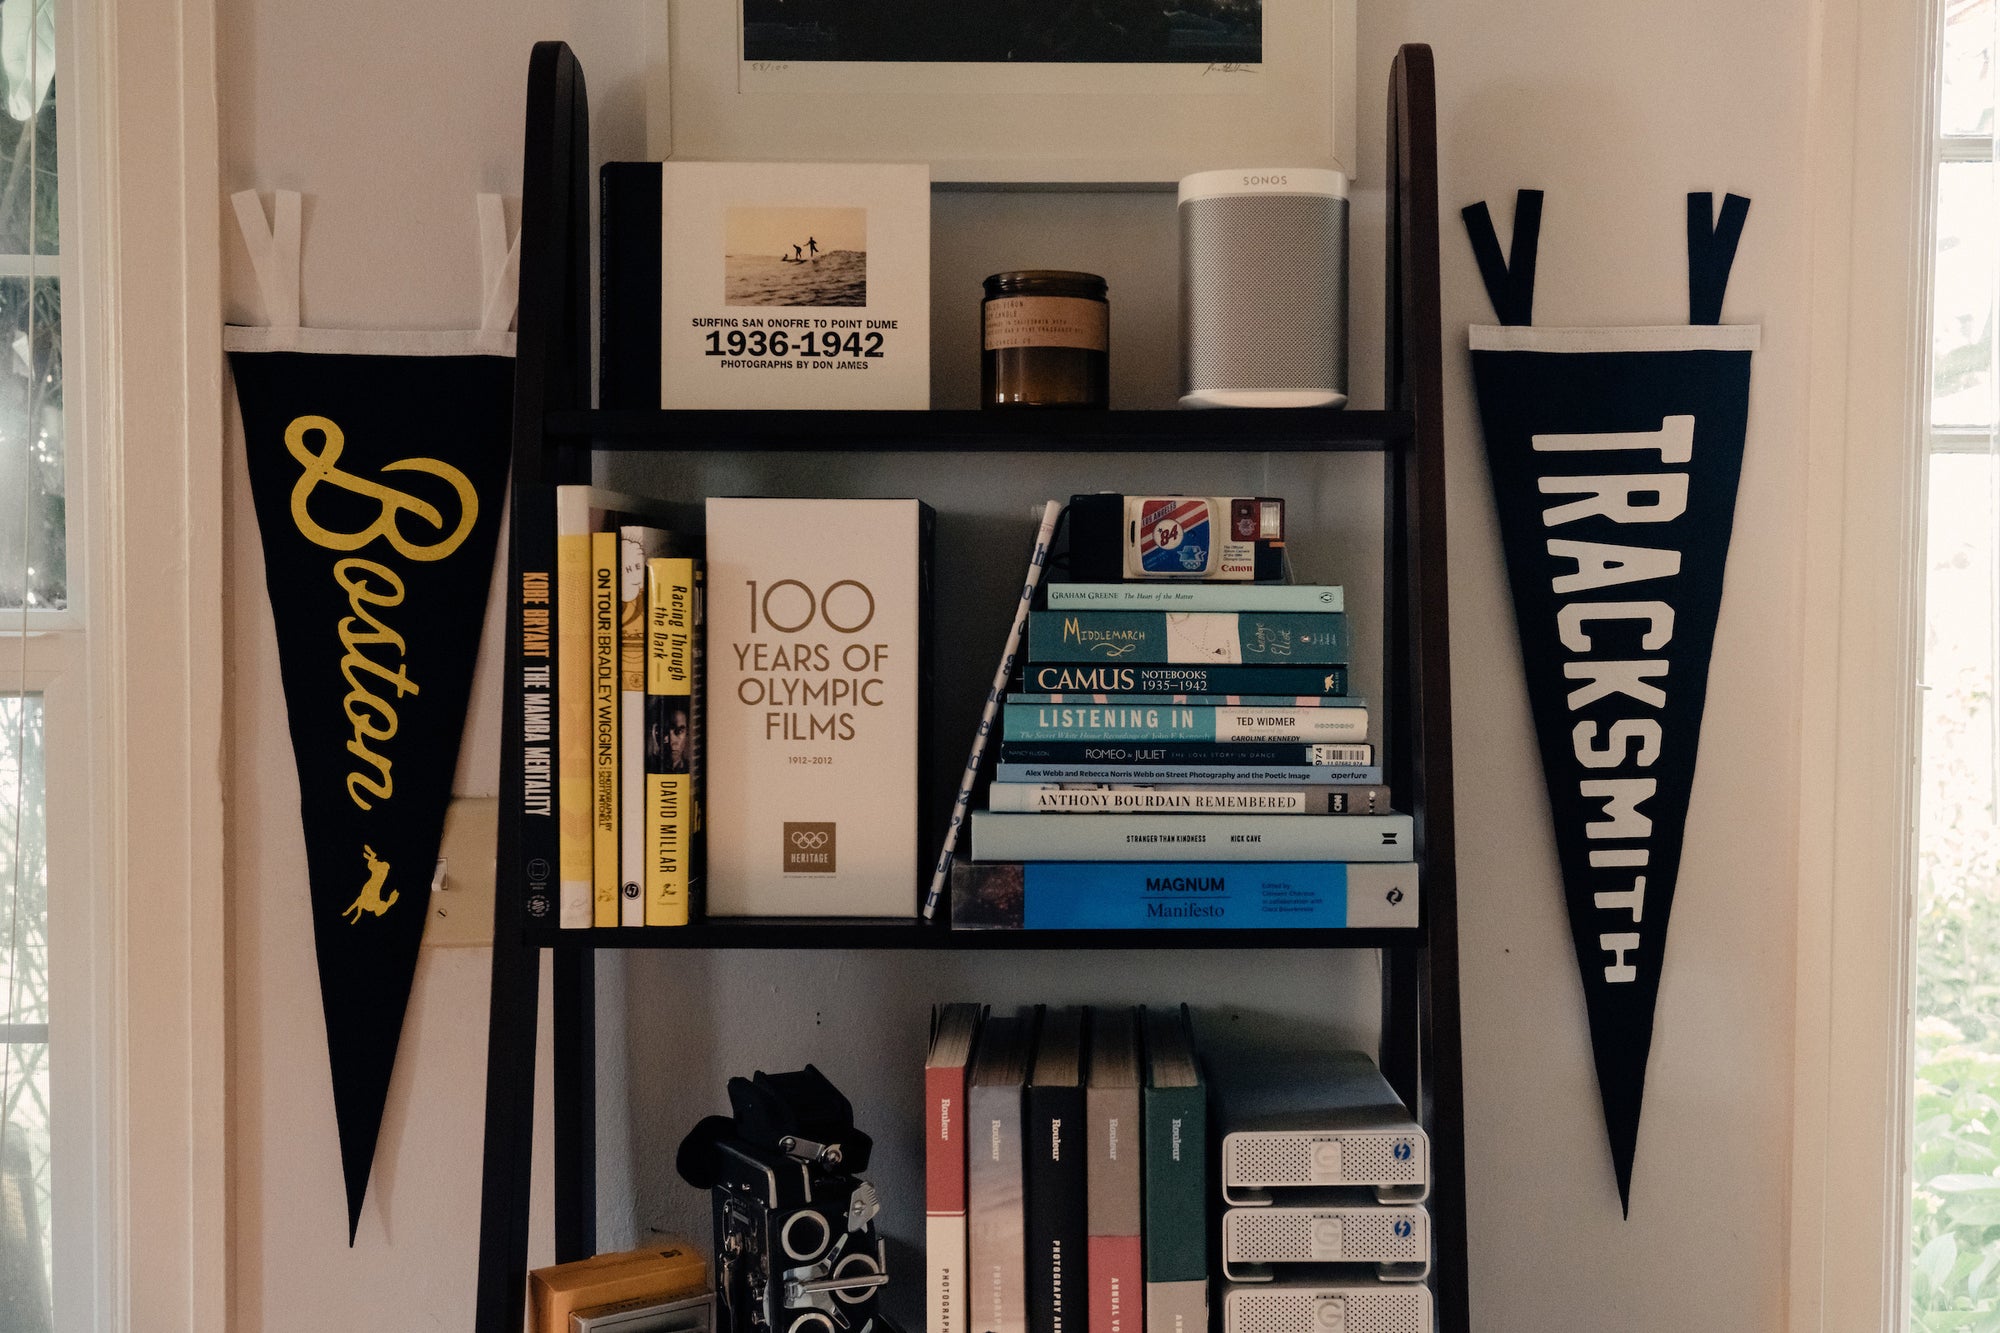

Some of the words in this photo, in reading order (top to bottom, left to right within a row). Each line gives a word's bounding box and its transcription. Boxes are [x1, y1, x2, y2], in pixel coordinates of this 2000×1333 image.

[1242, 175, 1287, 186] SONOS
[692, 318, 739, 328] SURFING
[742, 318, 764, 328] SAN
[767, 318, 810, 329] ONOFRE
[813, 319, 827, 329] TO
[831, 319, 862, 329] POINT
[866, 319, 899, 330] DUME
[704, 330, 885, 358] 1936-1942
[720, 359, 793, 370] PHOTOGRAPHS
[796, 360, 810, 370] BY
[812, 360, 833, 370] DON
[835, 360, 869, 370] JAMES
[597, 568, 611, 590] ON
[1221, 564, 1253, 572] Canon
[522, 571, 549, 604] KOBE
[1051, 591, 1086, 600] GRAHAM
[1087, 591, 1119, 600] GREENE
[1155, 592, 1162, 601] of
[284, 414, 479, 811] Boston
[597, 591, 611, 631] TOUR
[654, 607, 669, 627] the
[668, 585, 688, 627] Racing
[746, 579, 875, 633] 100
[523, 609, 550, 658] BRYANT
[1063, 616, 1146, 645] MIDDLEMARCH
[1246, 622, 1277, 653] George
[1270, 630, 1292, 656] Eliot
[653, 632, 669, 659] Dark
[668, 634, 687, 681] Through
[733, 643, 830, 672] YEARS
[842, 643, 889, 672] OF
[523, 665, 550, 688] THE
[598, 636, 612, 703] BRADLEY
[1037, 668, 1135, 691] CAMUS
[1141, 669, 1207, 681] NOTEBOOKS
[737, 677, 885, 707] OLYMPIC
[1531, 414, 1696, 984] TRACKSMITH
[524, 693, 550, 742] MAMBA
[766, 712, 856, 741] FILMS
[1039, 709, 1159, 728] LISTENING
[1172, 709, 1194, 728] IN
[1236, 716, 1254, 727] TED
[1257, 716, 1296, 727] WIDMER
[598, 704, 612, 766] WIGGINS
[1019, 731, 1034, 739] The
[1035, 731, 1056, 739] Secret
[1057, 731, 1077, 739] White
[788, 756, 833, 765] 1912-2012
[1085, 749, 1126, 760] ROMEO
[1134, 749, 1167, 761] JULIET
[524, 747, 551, 817] MENTALITY
[598, 771, 606, 794] SCOTT
[1042, 769, 1064, 777] Webb
[1065, 769, 1078, 777] and
[1079, 770, 1109, 778] Rebecca
[1110, 770, 1132, 778] Norris
[1133, 770, 1154, 778] Webb
[1189, 771, 1235, 780] Photography
[1288, 772, 1311, 780] Image
[1331, 772, 1367, 780] aperture
[605, 770, 613, 822] PHOTOGRAPHS
[660, 781, 678, 819] DAVID
[1038, 794, 1110, 807] ANTHONY
[1114, 795, 1191, 807] BOURDAIN
[1196, 796, 1296, 808] REMEMBERED
[1333, 794, 1343, 812] CNN
[598, 795, 606, 828] MITCHELL
[605, 823, 613, 832] BY
[1126, 835, 1158, 843] STRANGER
[1159, 835, 1175, 843] THAN
[1176, 835, 1206, 843] KINDNESS
[1230, 835, 1245, 843] NICK
[1246, 835, 1261, 843] CAVE
[660, 824, 677, 873] MILLAR
[791, 853, 828, 864] HERITAGE
[1145, 877, 1225, 892] MAGNUM
[1147, 902, 1225, 918] Manifesto
[941, 1098, 951, 1141] Rouleur
[992, 1119, 1001, 1161] Rouleur
[1052, 1118, 1061, 1162] Rouleur
[1109, 1118, 1118, 1161] Rouleur
[1172, 1118, 1182, 1161] Rouleur
[1052, 1240, 1062, 1313] PHOTOGRAPHY
[942, 1268, 950, 1333] PHOTOGRAPH
[1111, 1277, 1120, 1316] ANNUAL
